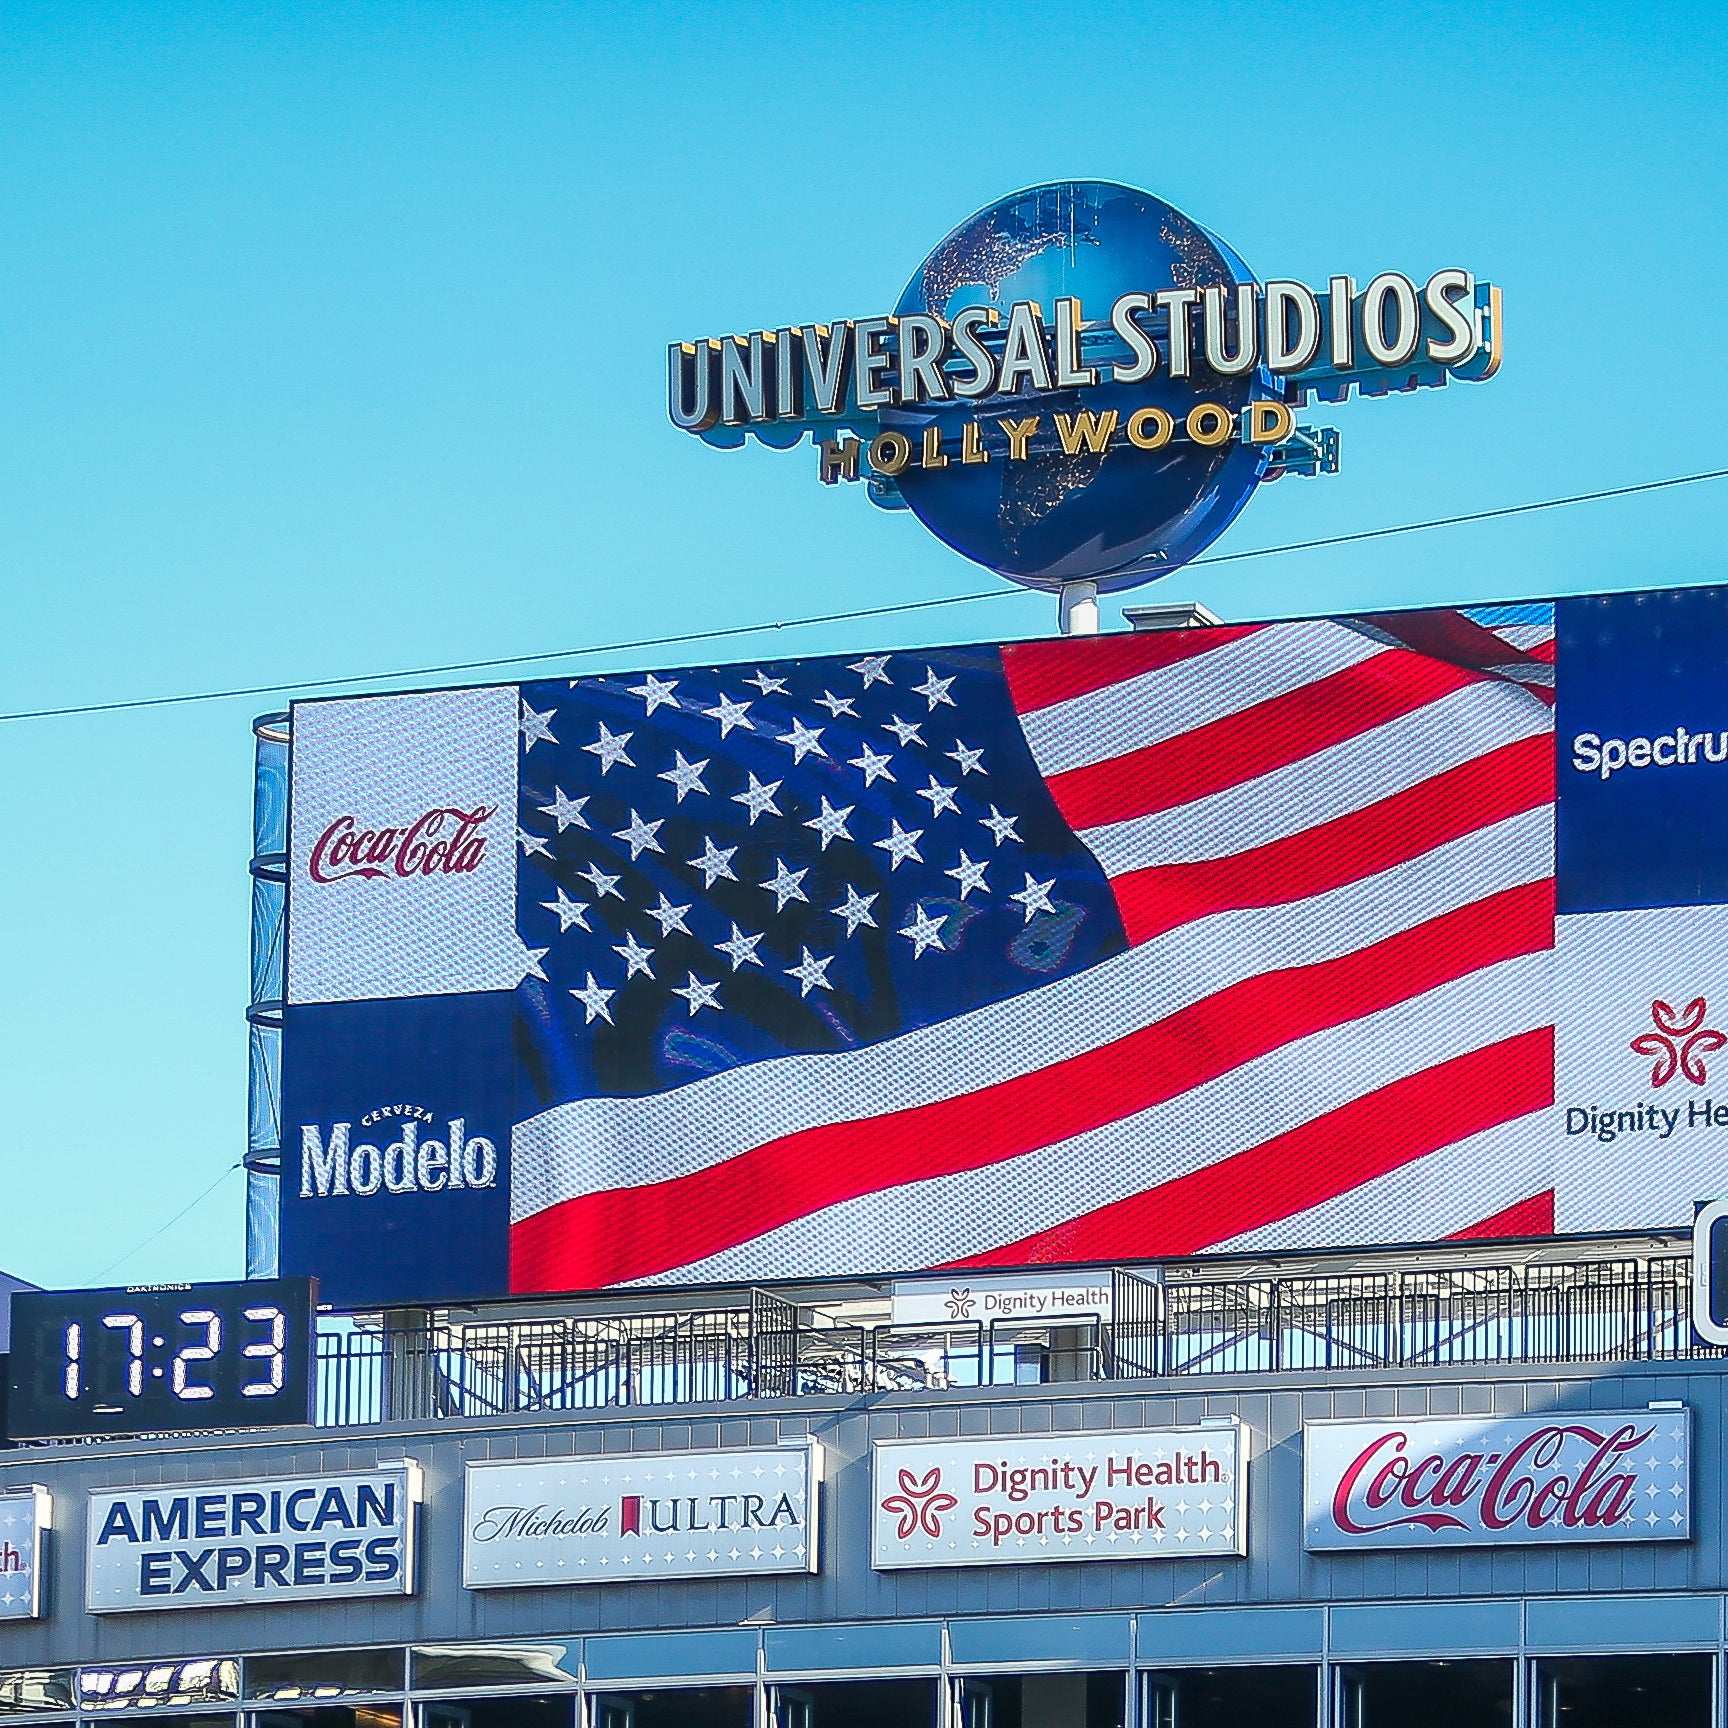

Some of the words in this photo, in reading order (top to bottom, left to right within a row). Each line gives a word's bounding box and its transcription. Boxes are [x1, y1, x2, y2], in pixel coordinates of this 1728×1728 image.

[668, 295, 1098, 432] UNIVERSAL
[1112, 269, 1480, 386] STUDIOS
[821, 399, 1298, 481] HOLLYWOOD
[310, 804, 498, 883] Coca-Cola
[362, 1104, 434, 1126] CERVEZA
[1565, 1102, 1679, 1140] Dignity
[300, 1117, 497, 1197] Modelo
[983, 1289, 1047, 1314] Dignity
[1051, 1287, 1110, 1308] Health
[65, 1307, 286, 1400] 17:23
[974, 1459, 1099, 1499] Dignity
[1331, 1424, 1660, 1535] Coca-Cola
[97, 1483, 396, 1545] AMERICAN
[472, 1502, 613, 1542] Michelob
[648, 1490, 801, 1532] ULTRA
[973, 1506, 1082, 1546] Sports
[1094, 1497, 1165, 1532] Park
[140, 1536, 400, 1597] EXPRESS
